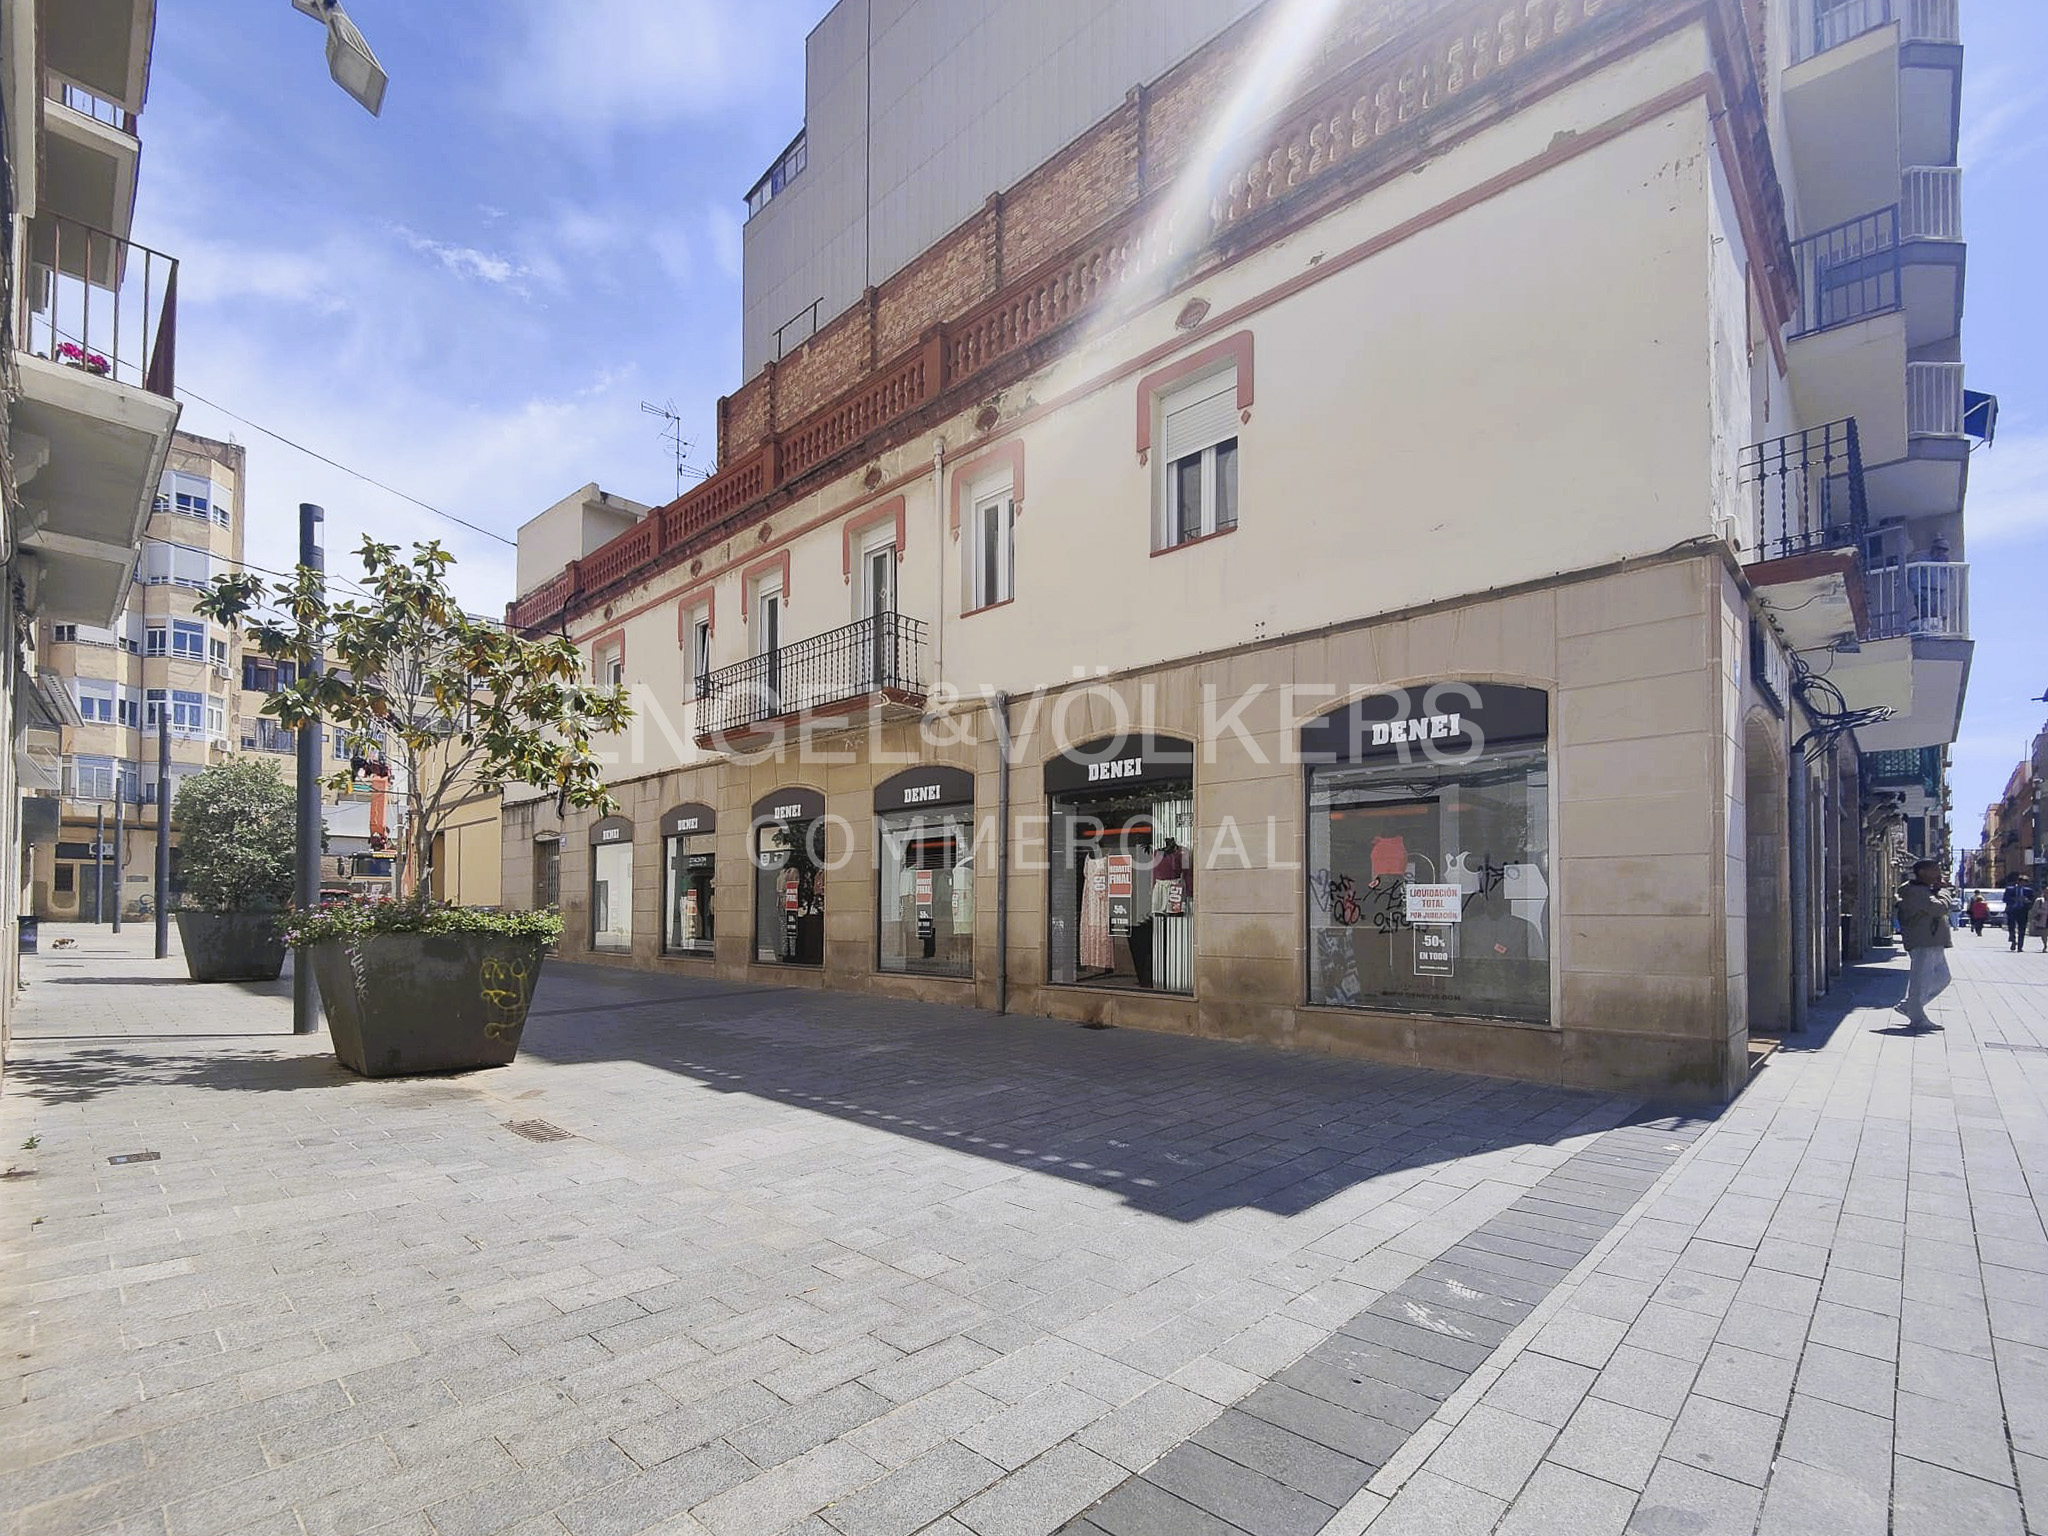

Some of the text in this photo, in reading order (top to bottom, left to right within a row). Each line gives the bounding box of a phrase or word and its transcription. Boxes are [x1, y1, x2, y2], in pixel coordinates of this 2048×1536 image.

[1371, 713, 1460, 746] DENEI
[1088, 757, 1142, 782] DENEI
[903, 784, 941, 804] DENEI
[774, 804, 802, 820] DENEI
[1409, 886, 1458, 899] LIQUIDACIÓN
[1421, 899, 1445, 908] TOTAL
[1422, 935, 1446, 948] -50%
[1429, 952, 1448, 961] TODO
